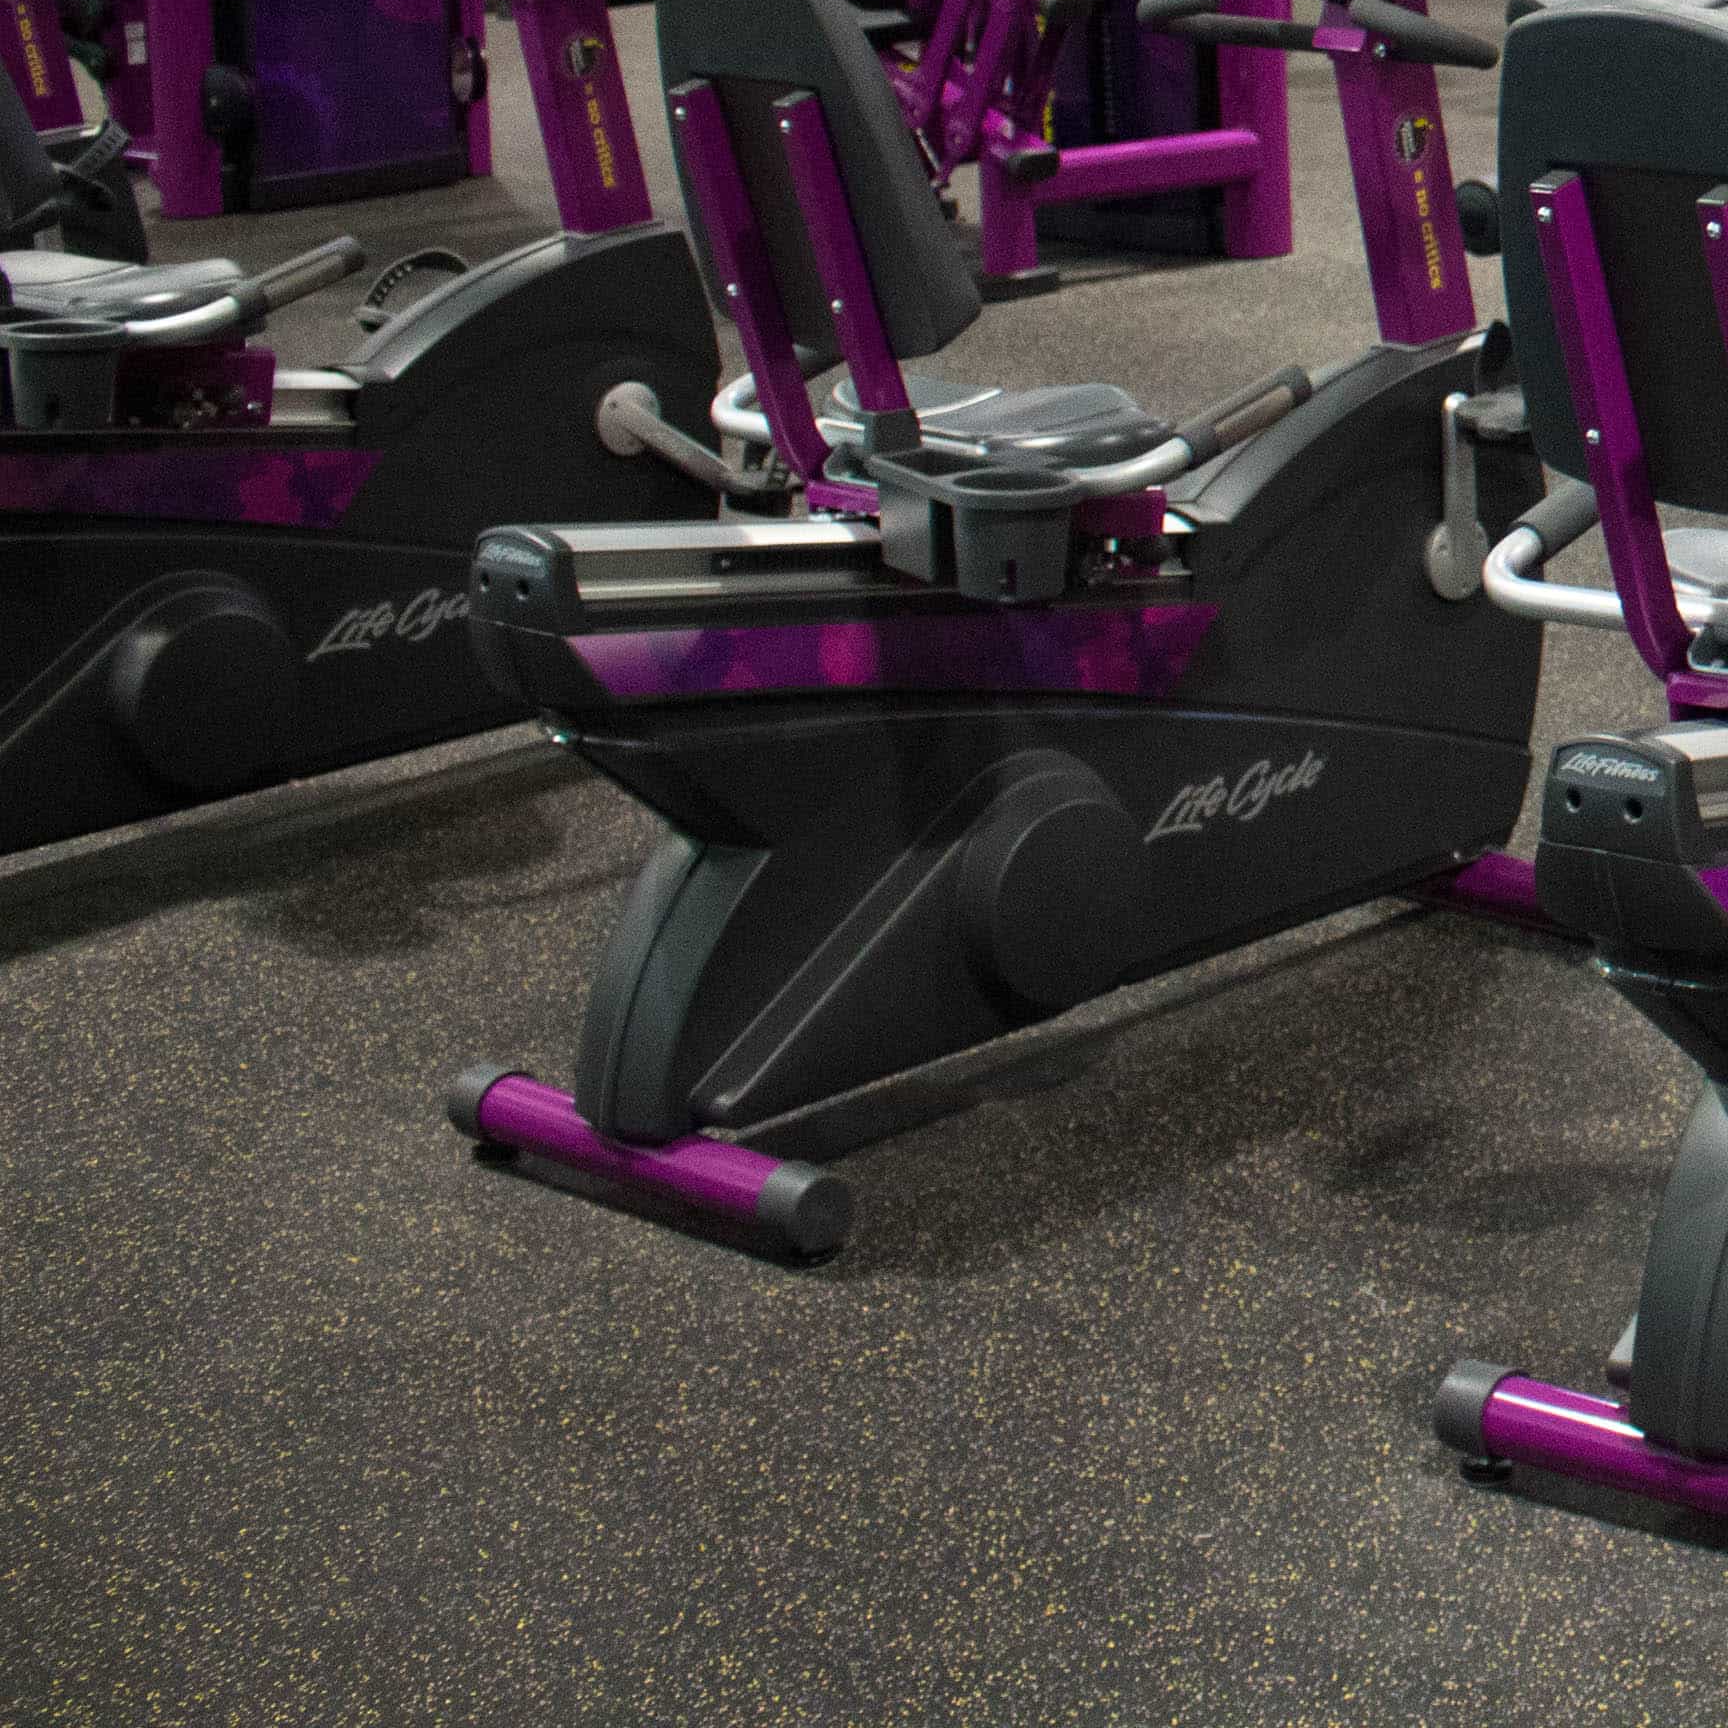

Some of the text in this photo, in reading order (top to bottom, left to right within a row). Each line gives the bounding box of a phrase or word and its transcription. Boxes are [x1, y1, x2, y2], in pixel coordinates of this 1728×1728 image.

[306, 601, 395, 663] Life
[1144, 749, 1326, 842] Life Cycle
